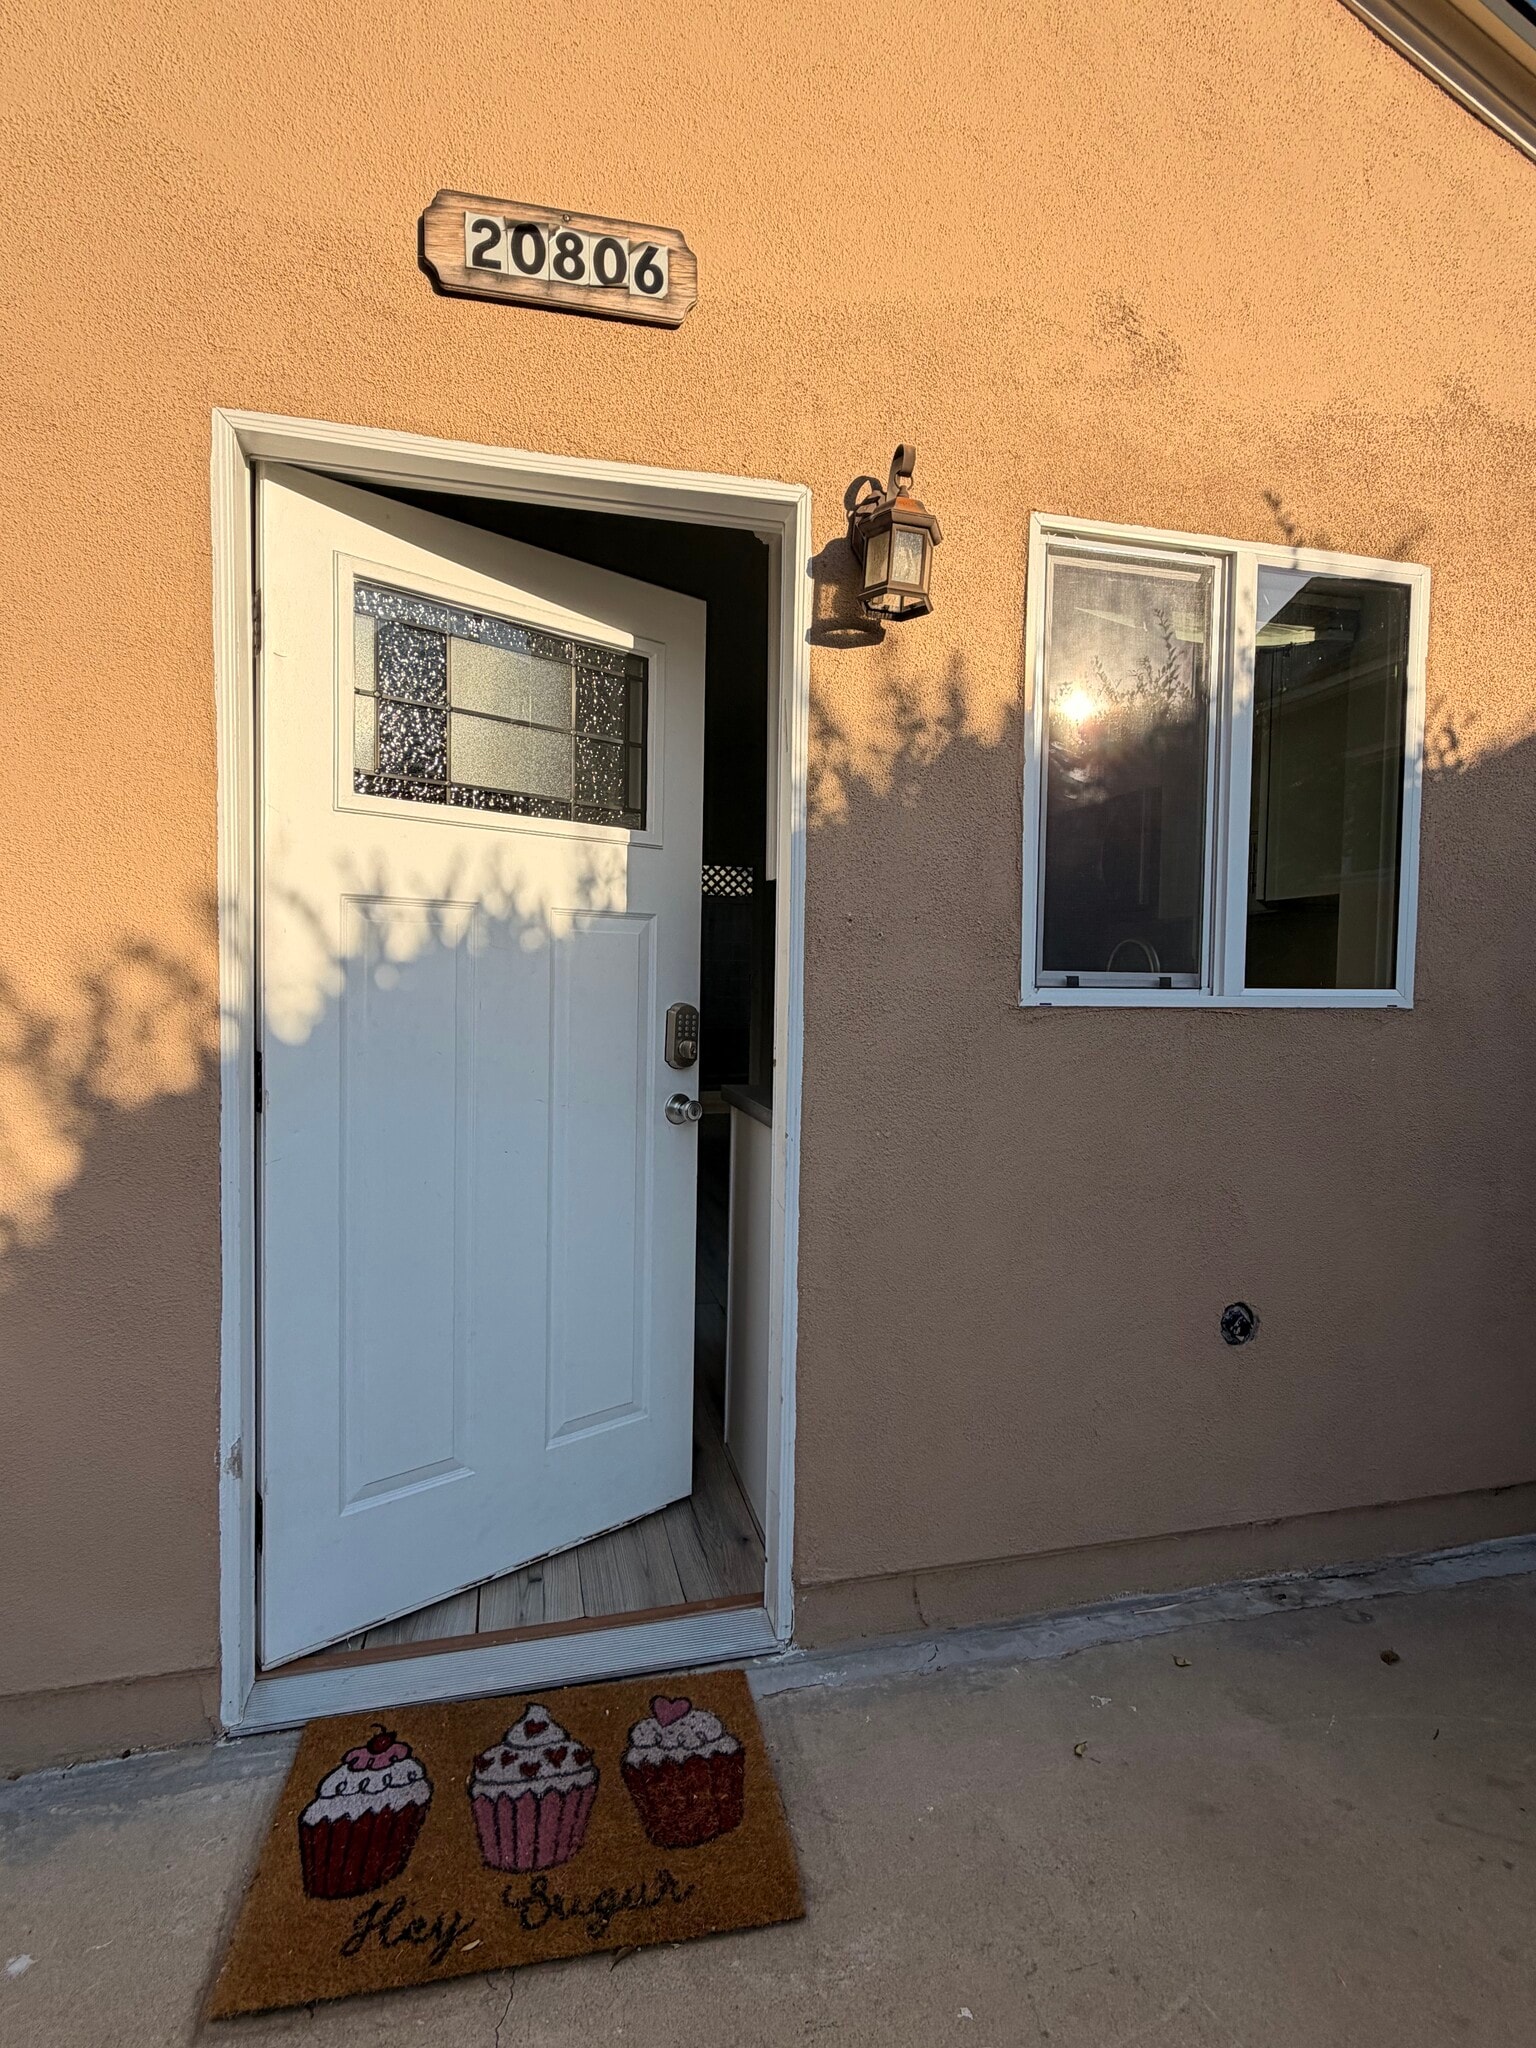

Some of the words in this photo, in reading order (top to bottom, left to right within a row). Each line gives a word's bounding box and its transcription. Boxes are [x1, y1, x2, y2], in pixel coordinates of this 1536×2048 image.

[471, 218, 664, 295] 20806
[339, 1896, 475, 1966] Hey
[500, 1868, 696, 1939] Sugar
